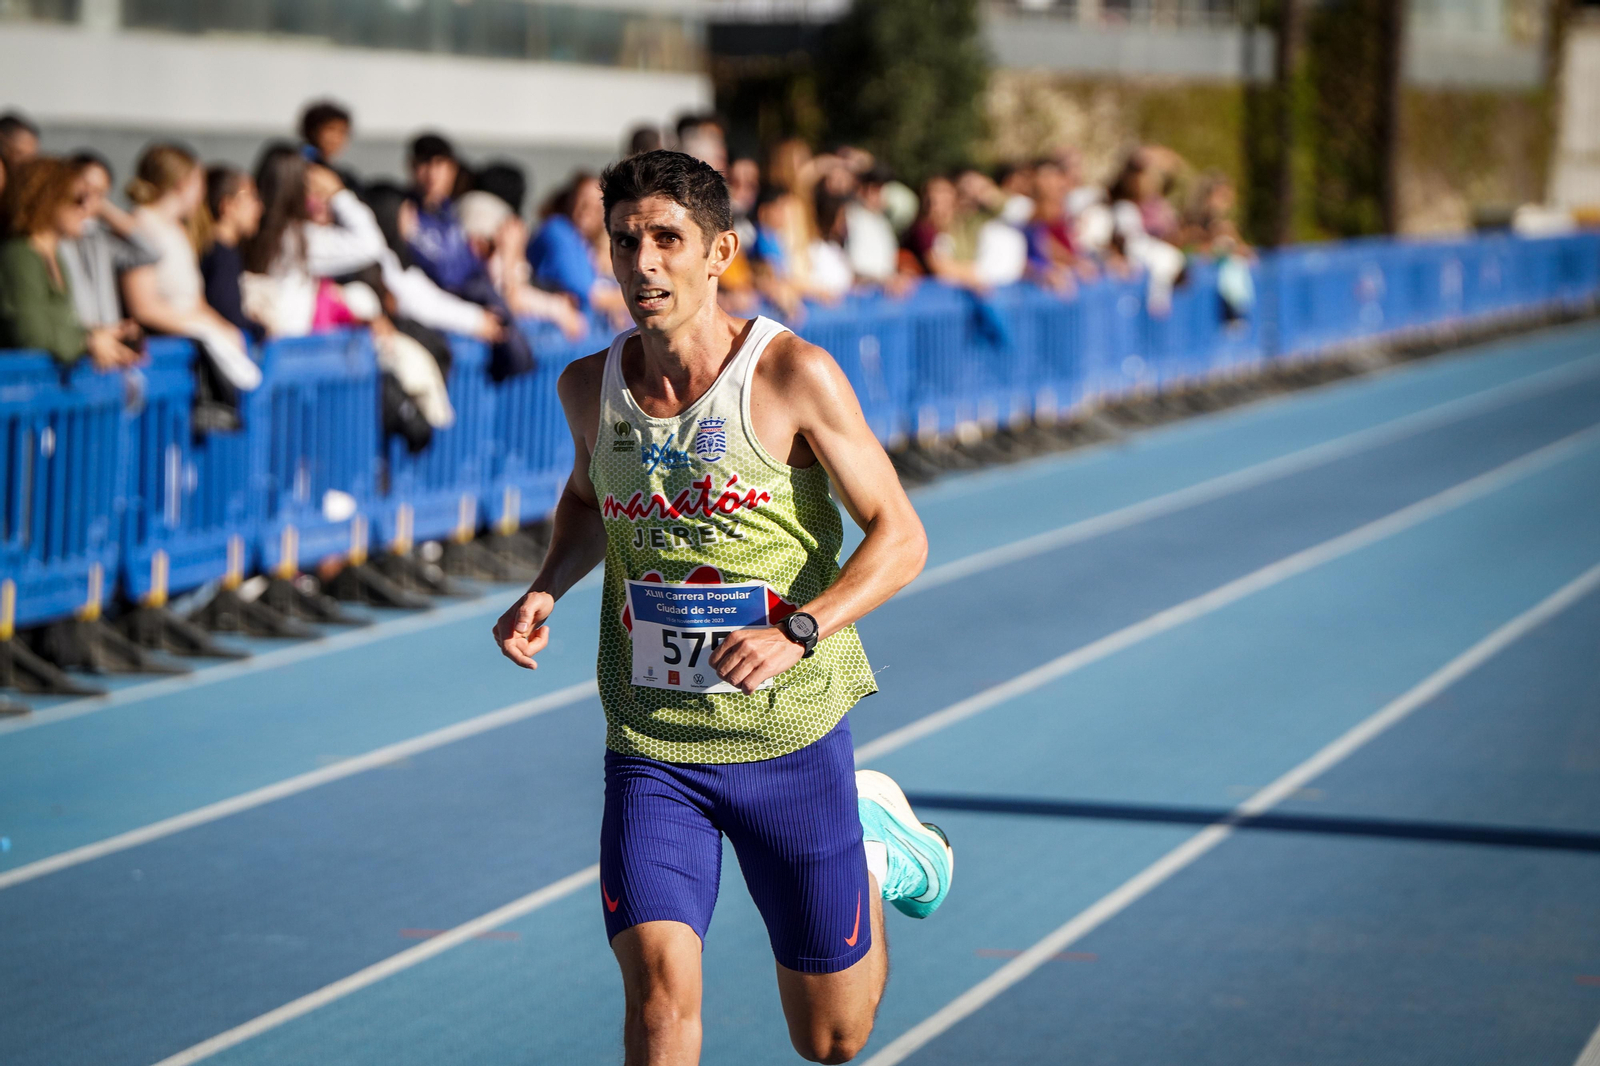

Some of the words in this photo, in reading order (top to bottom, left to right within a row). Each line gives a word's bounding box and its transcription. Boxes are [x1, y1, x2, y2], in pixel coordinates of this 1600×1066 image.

[603, 474, 771, 520] maratón
[633, 520, 744, 548] JEREZ
[644, 588, 664, 599] XLIII
[665, 591, 704, 601] Carrera
[707, 590, 751, 602] Popular
[656, 603, 688, 615] Ciudad
[690, 605, 705, 615] de
[707, 605, 737, 614] Jerez
